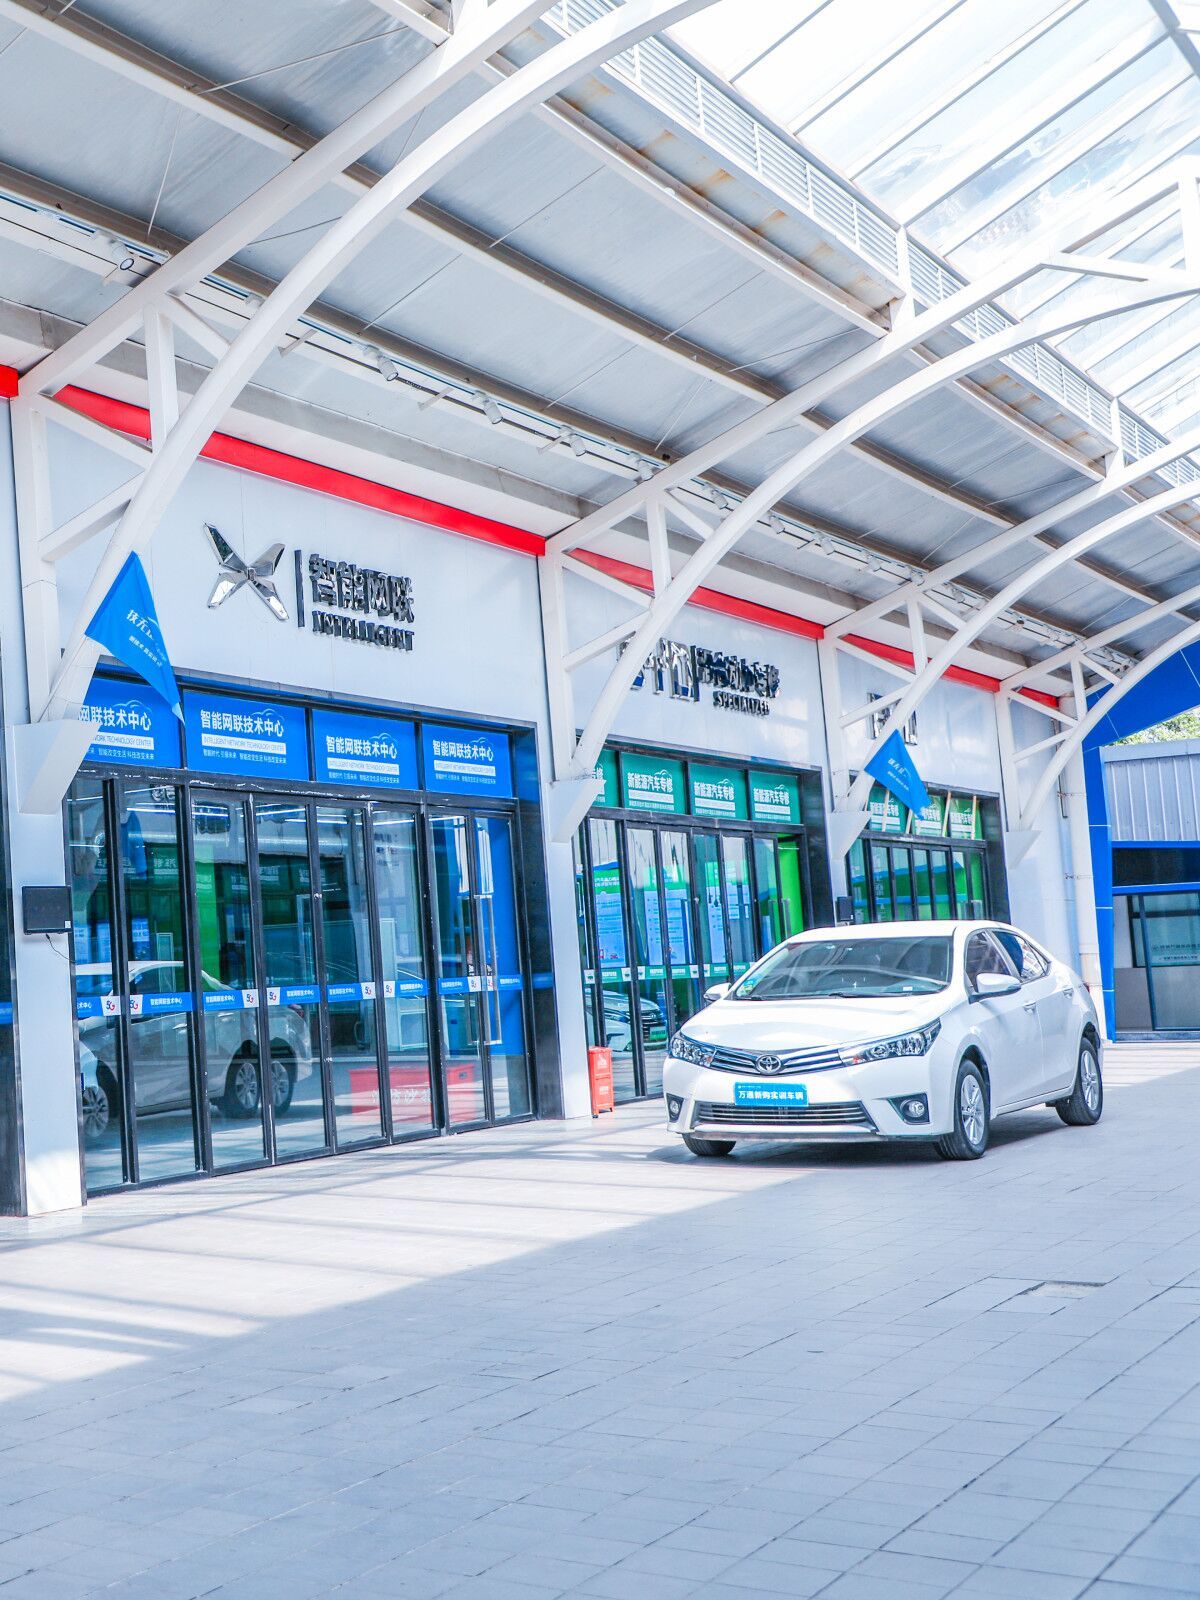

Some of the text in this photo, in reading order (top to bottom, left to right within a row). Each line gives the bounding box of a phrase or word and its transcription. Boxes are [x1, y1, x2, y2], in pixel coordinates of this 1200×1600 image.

[309, 554, 414, 623] 智能网联
[201, 709, 284, 737] 智能网联技术中心
[326, 735, 397, 760] 智能网联技术中心
[433, 739, 494, 761] 智能网联技术中心
[106, 1000, 116, 1011] 5G
